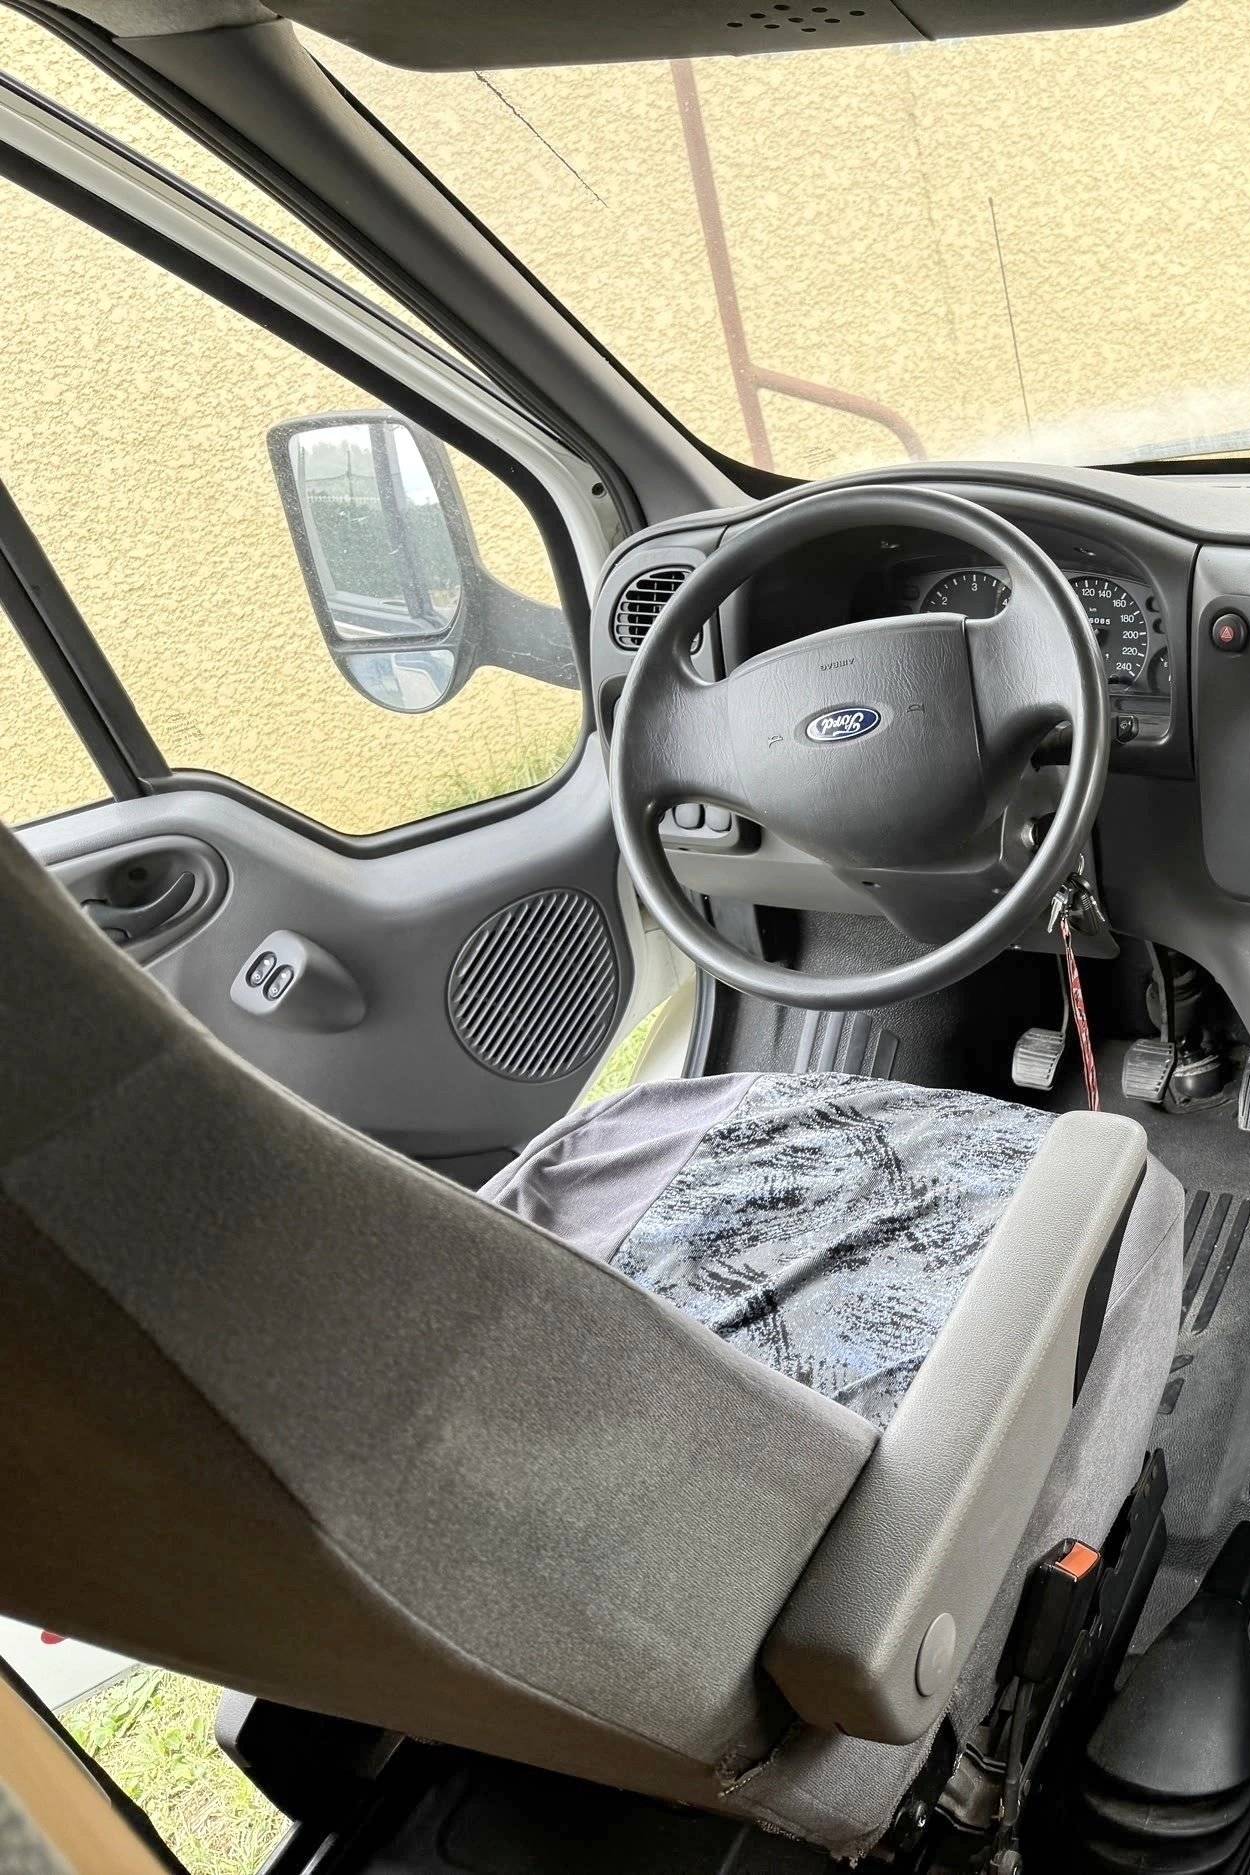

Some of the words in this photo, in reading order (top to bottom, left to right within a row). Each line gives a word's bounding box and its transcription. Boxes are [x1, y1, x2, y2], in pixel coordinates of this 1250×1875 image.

[971, 583, 978, 591] 3
[1081, 588, 1095, 596] 120
[1098, 590, 1111, 598] 140
[941, 596, 948, 605] 2
[1113, 600, 1126, 608] 160
[1120, 615, 1134, 623] 180
[1122, 631, 1139, 639] 200
[1122, 647, 1138, 655] 220
[1116, 662, 1132, 671] 240
